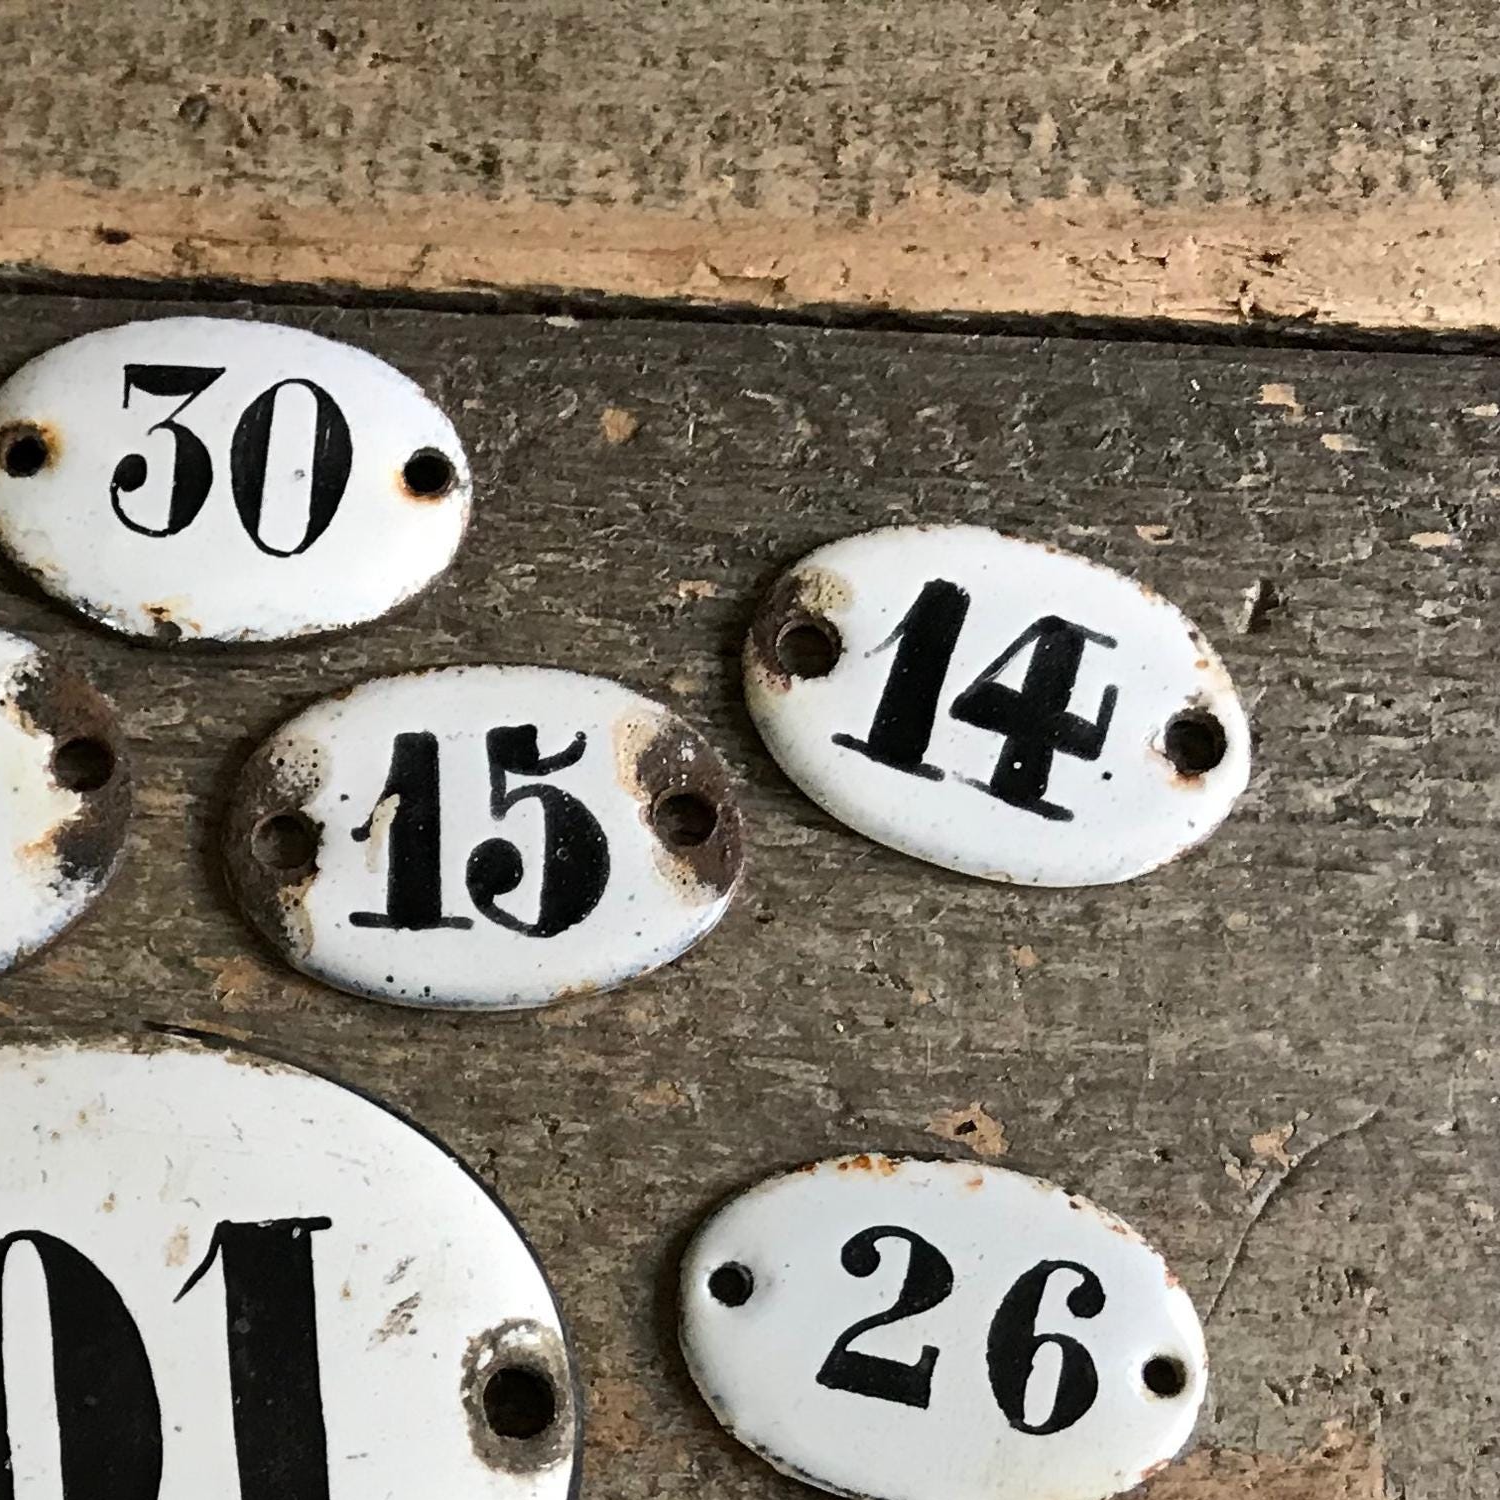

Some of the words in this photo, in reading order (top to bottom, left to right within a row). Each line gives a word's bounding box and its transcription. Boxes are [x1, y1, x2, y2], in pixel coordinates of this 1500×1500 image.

[108, 362, 354, 559] 30
[830, 577, 1119, 823] 14
[347, 722, 612, 940] 15
[814, 1224, 1108, 1437] 26
